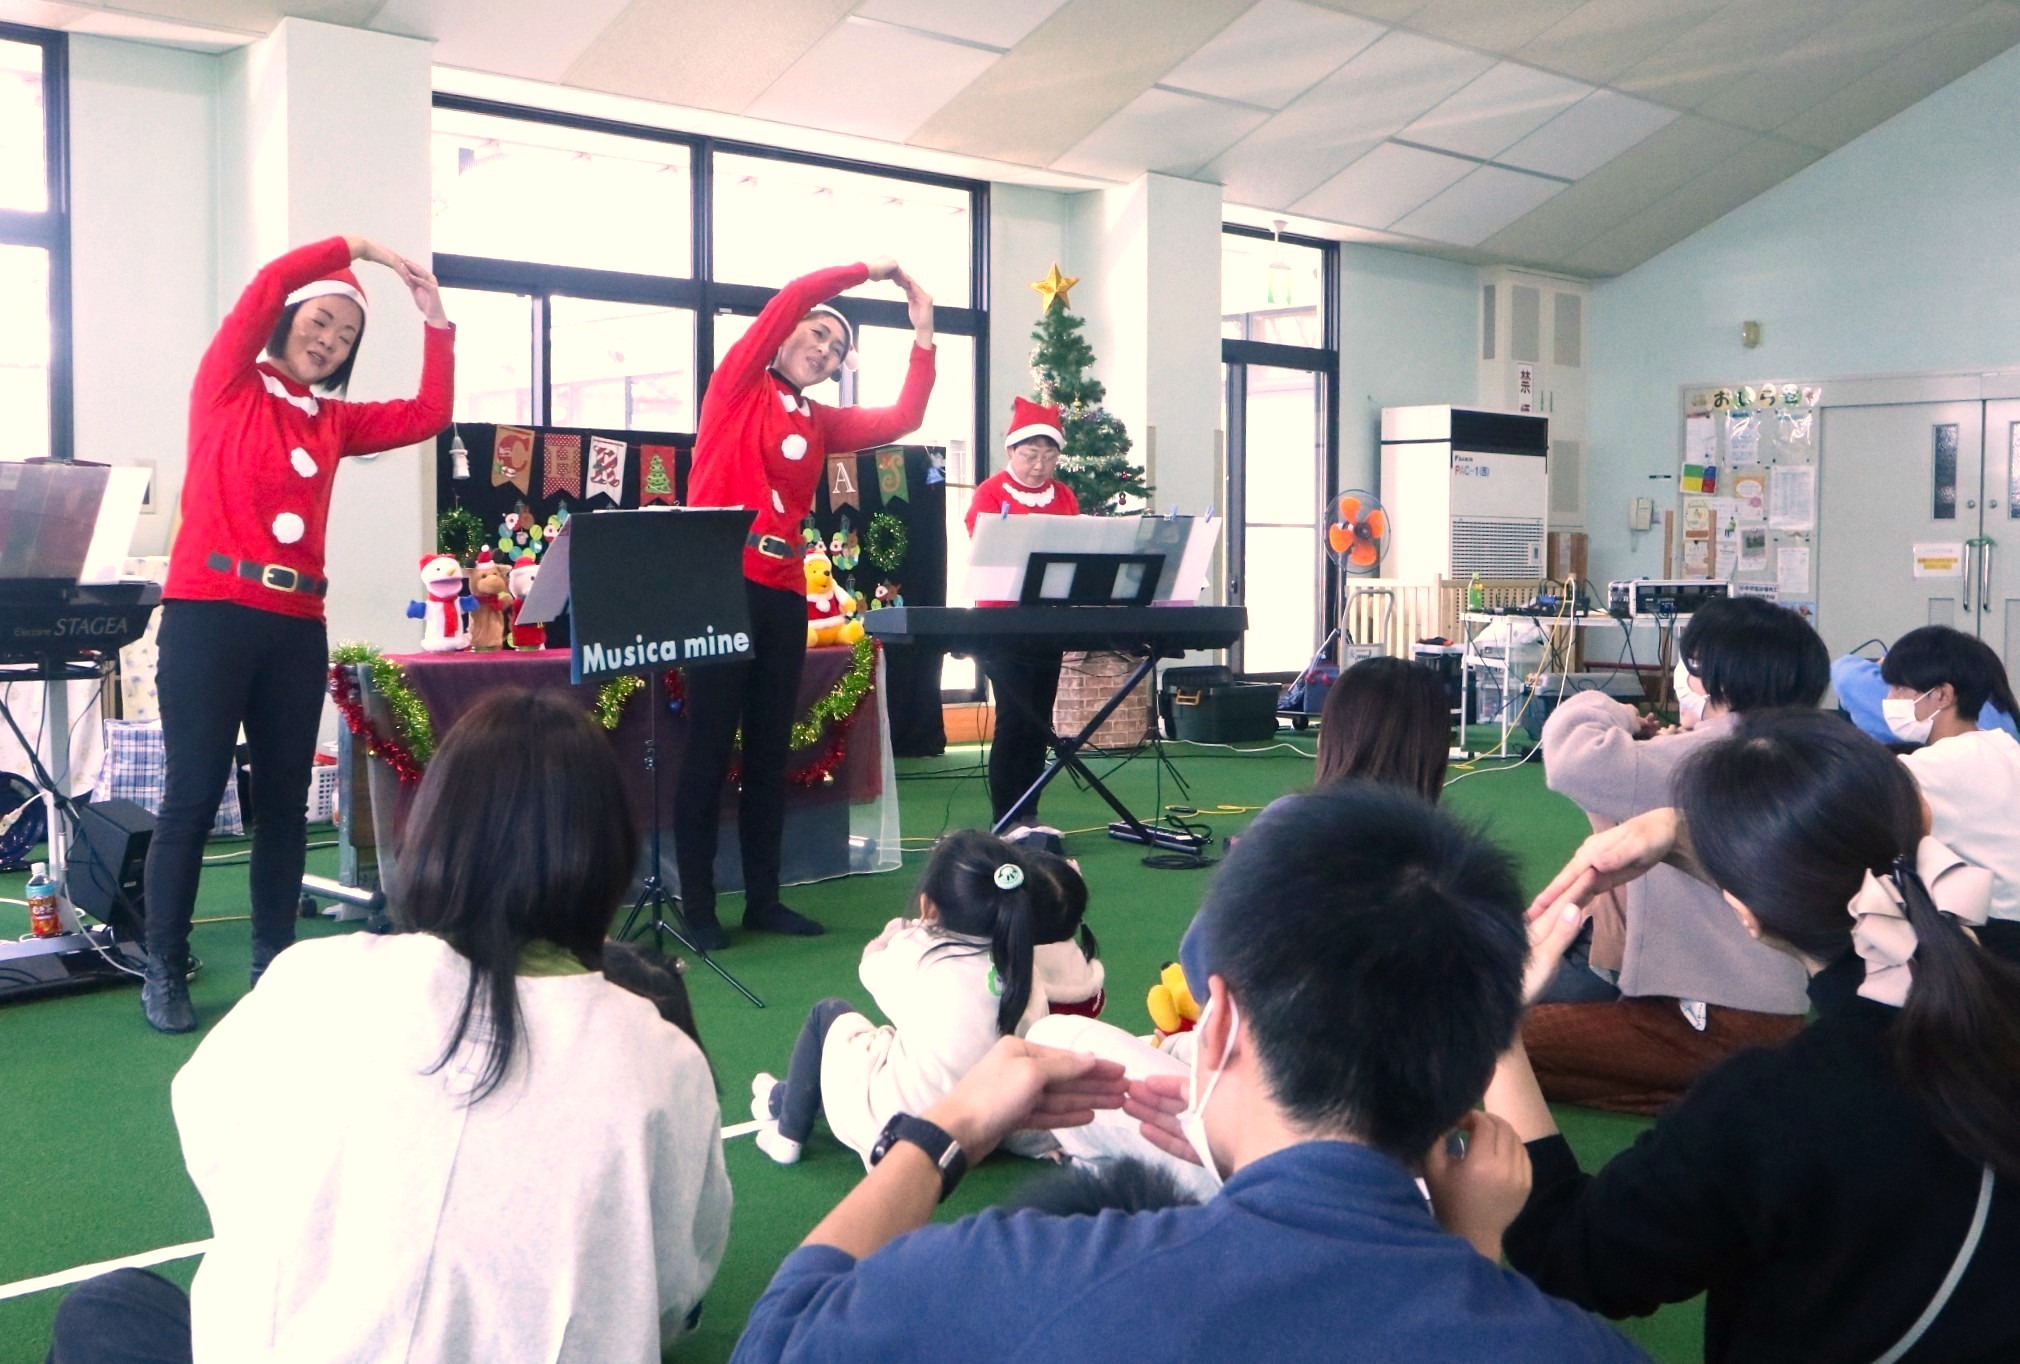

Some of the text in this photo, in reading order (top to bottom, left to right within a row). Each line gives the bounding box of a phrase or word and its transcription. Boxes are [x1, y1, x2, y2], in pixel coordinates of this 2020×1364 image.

[54, 617, 128, 636] STAGEA
[582, 624, 750, 675] Musica mine
